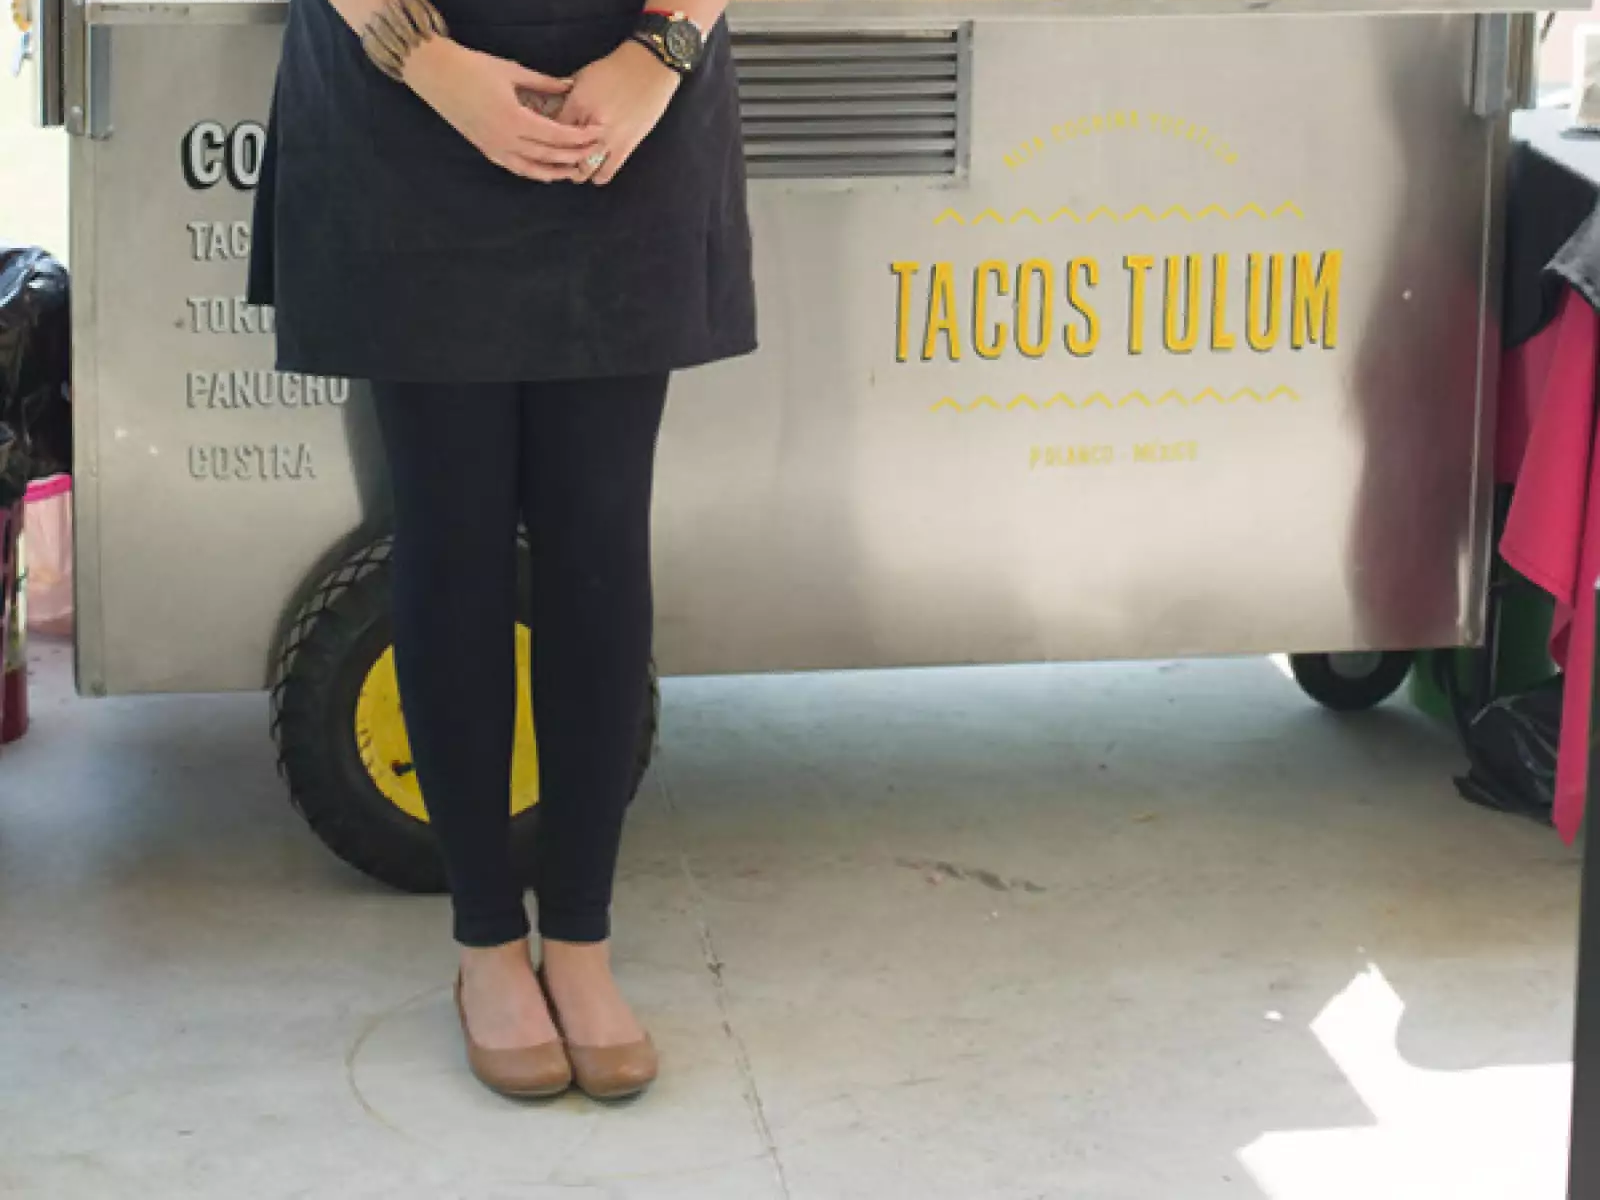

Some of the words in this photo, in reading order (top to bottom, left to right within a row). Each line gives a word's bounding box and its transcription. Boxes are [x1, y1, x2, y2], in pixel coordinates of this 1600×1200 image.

[181, 119, 266, 190] CO
[186, 220, 250, 261] TAC
[187, 295, 276, 334] TORT
[890, 255, 1100, 362] TACOS
[1123, 249, 1344, 356] TULUM
[186, 370, 351, 409] PANUCHO
[188, 443, 317, 481] COSTRA
